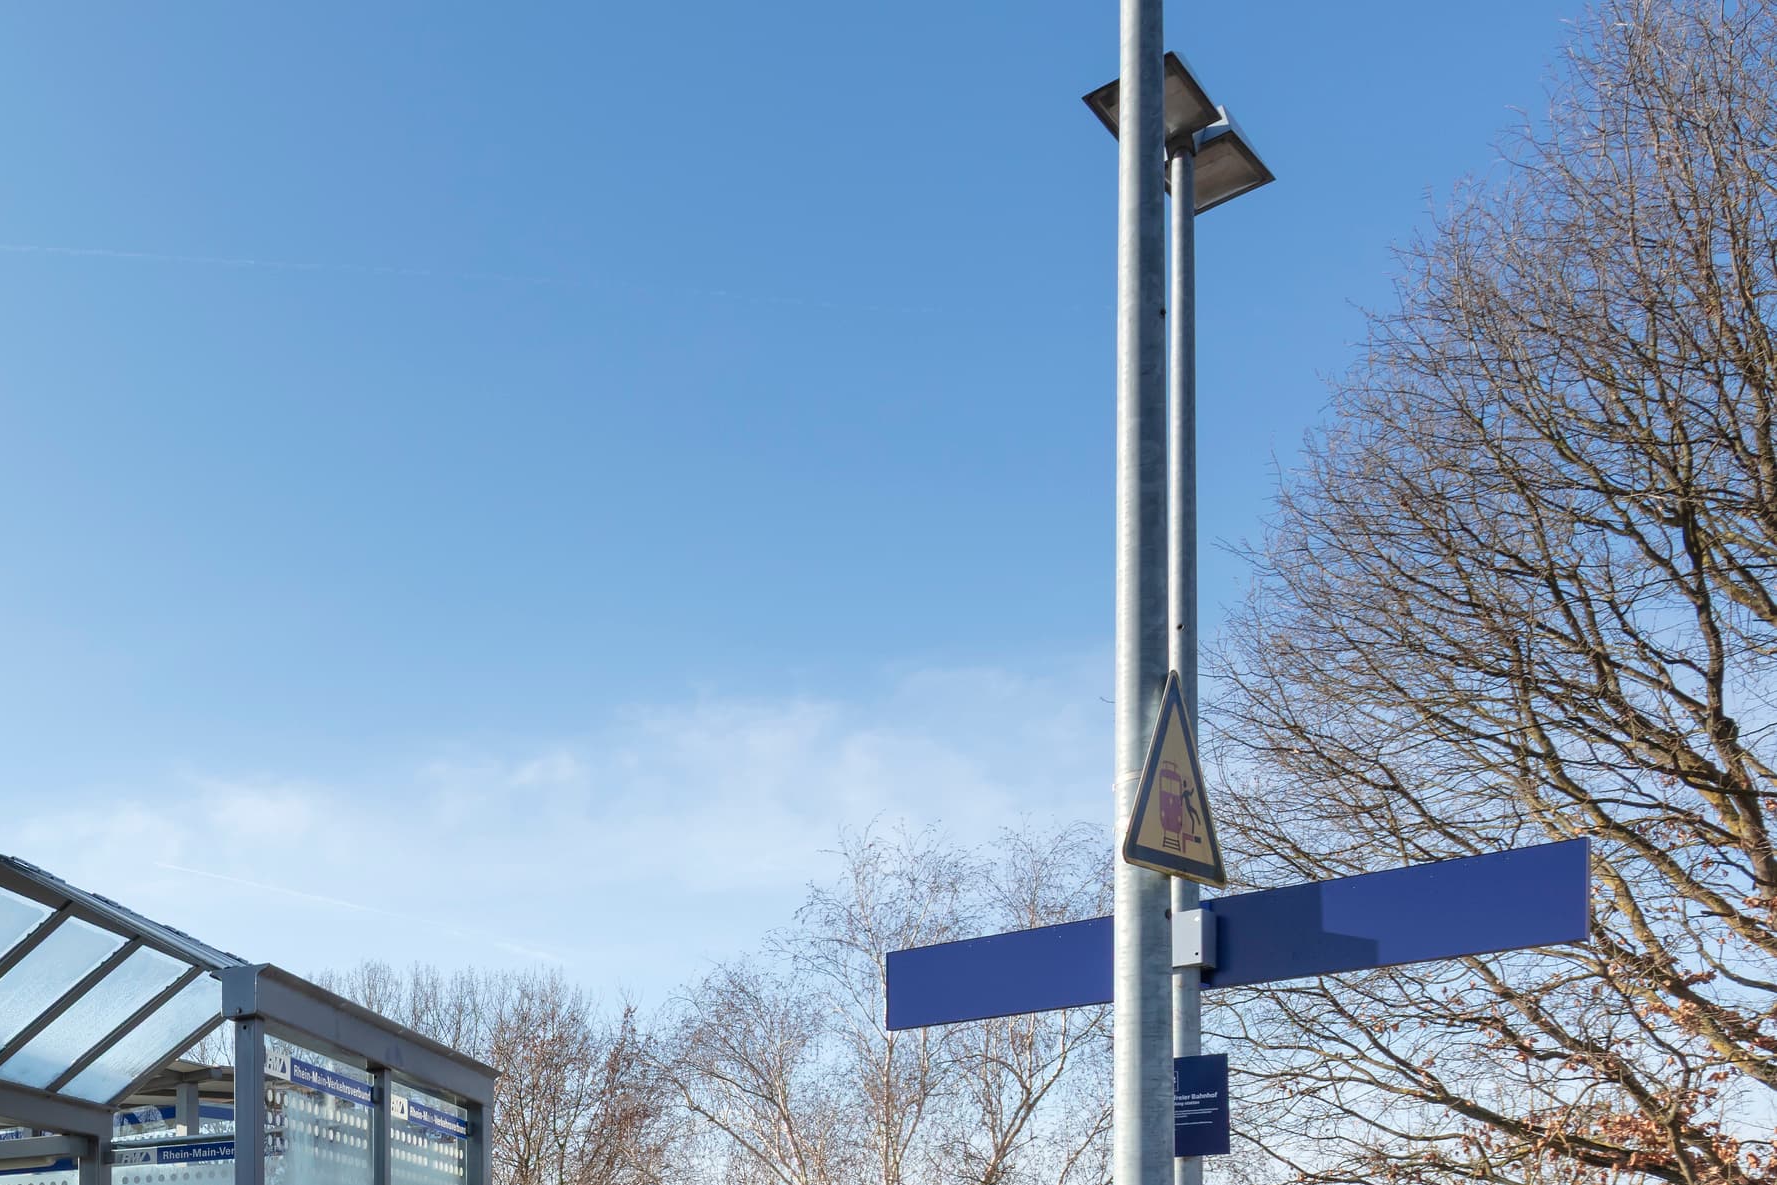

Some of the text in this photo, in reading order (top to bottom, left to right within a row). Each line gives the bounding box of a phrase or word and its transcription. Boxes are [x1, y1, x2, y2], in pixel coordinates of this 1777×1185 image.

[293, 1064, 371, 1101] Rhein-Main-Verkehrsverbund
[1191, 1091, 1218, 1100] Bahnhof
[162, 1146, 235, 1160] Rhein-Main-Ver
